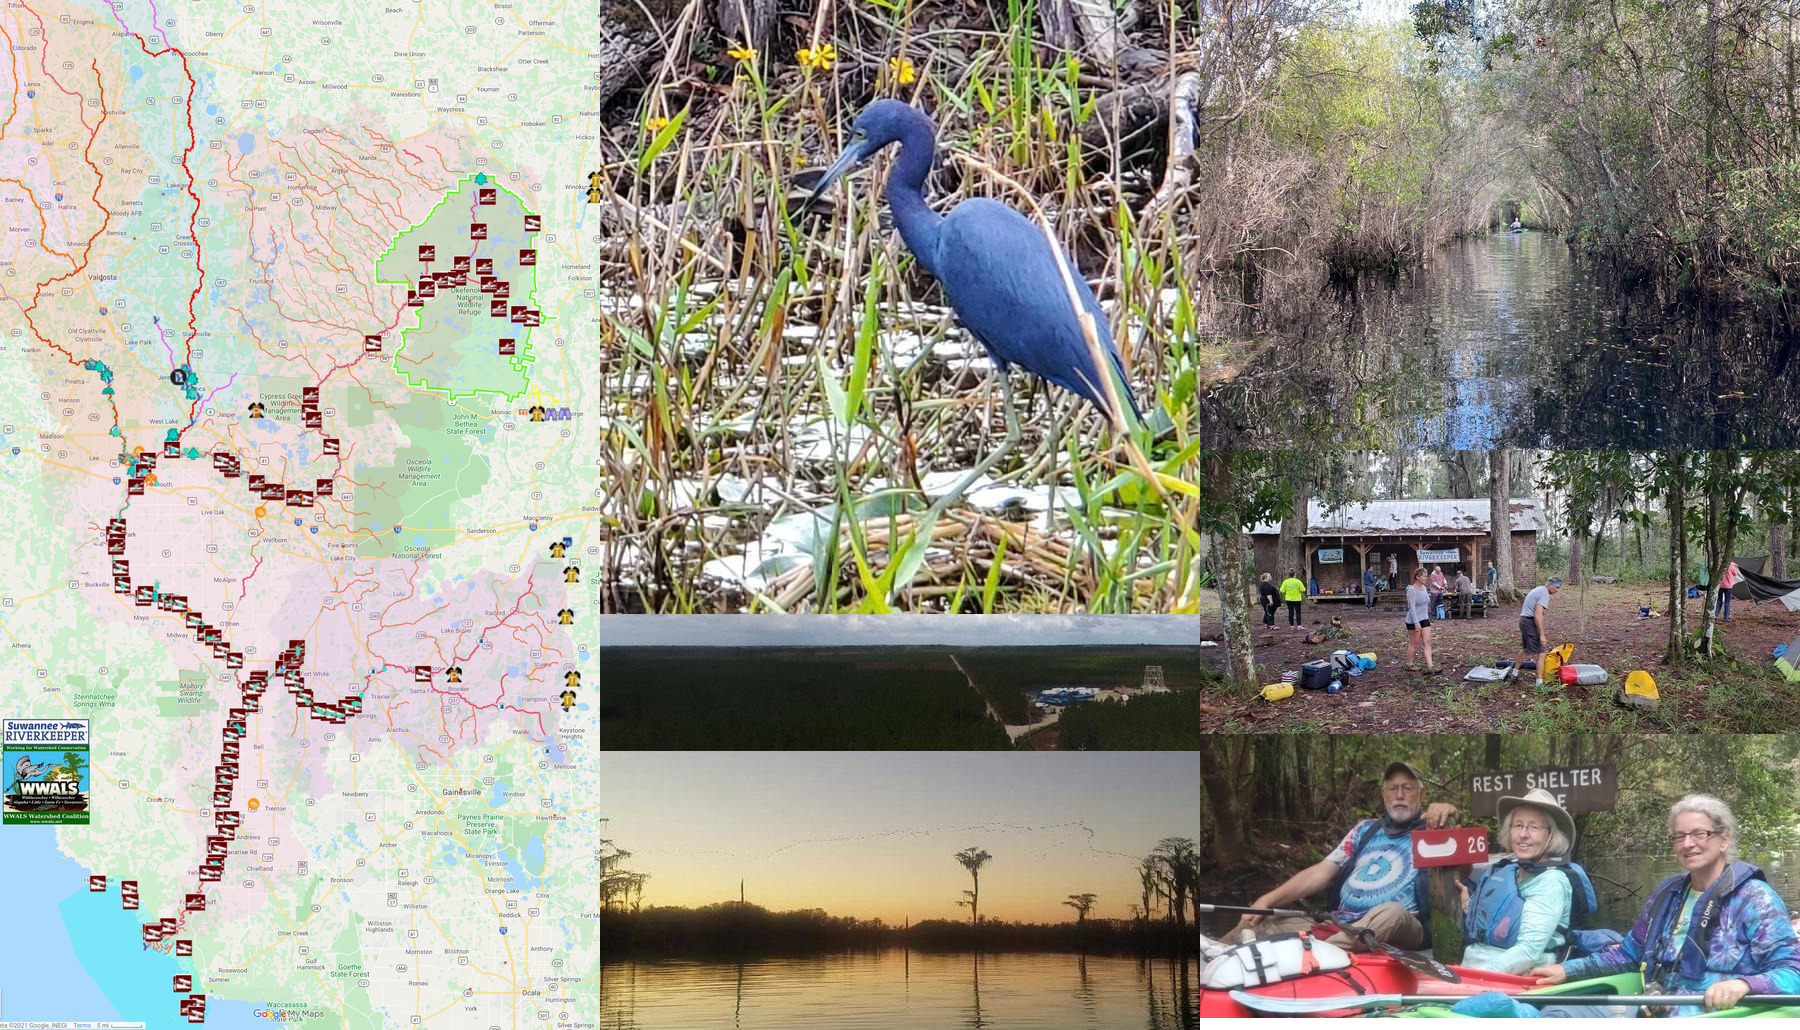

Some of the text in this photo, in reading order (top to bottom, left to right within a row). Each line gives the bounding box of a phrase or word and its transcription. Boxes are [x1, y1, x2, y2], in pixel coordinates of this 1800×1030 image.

[1473, 768, 1602, 792] REST SHELTER
[1468, 836, 1485, 853] 26
